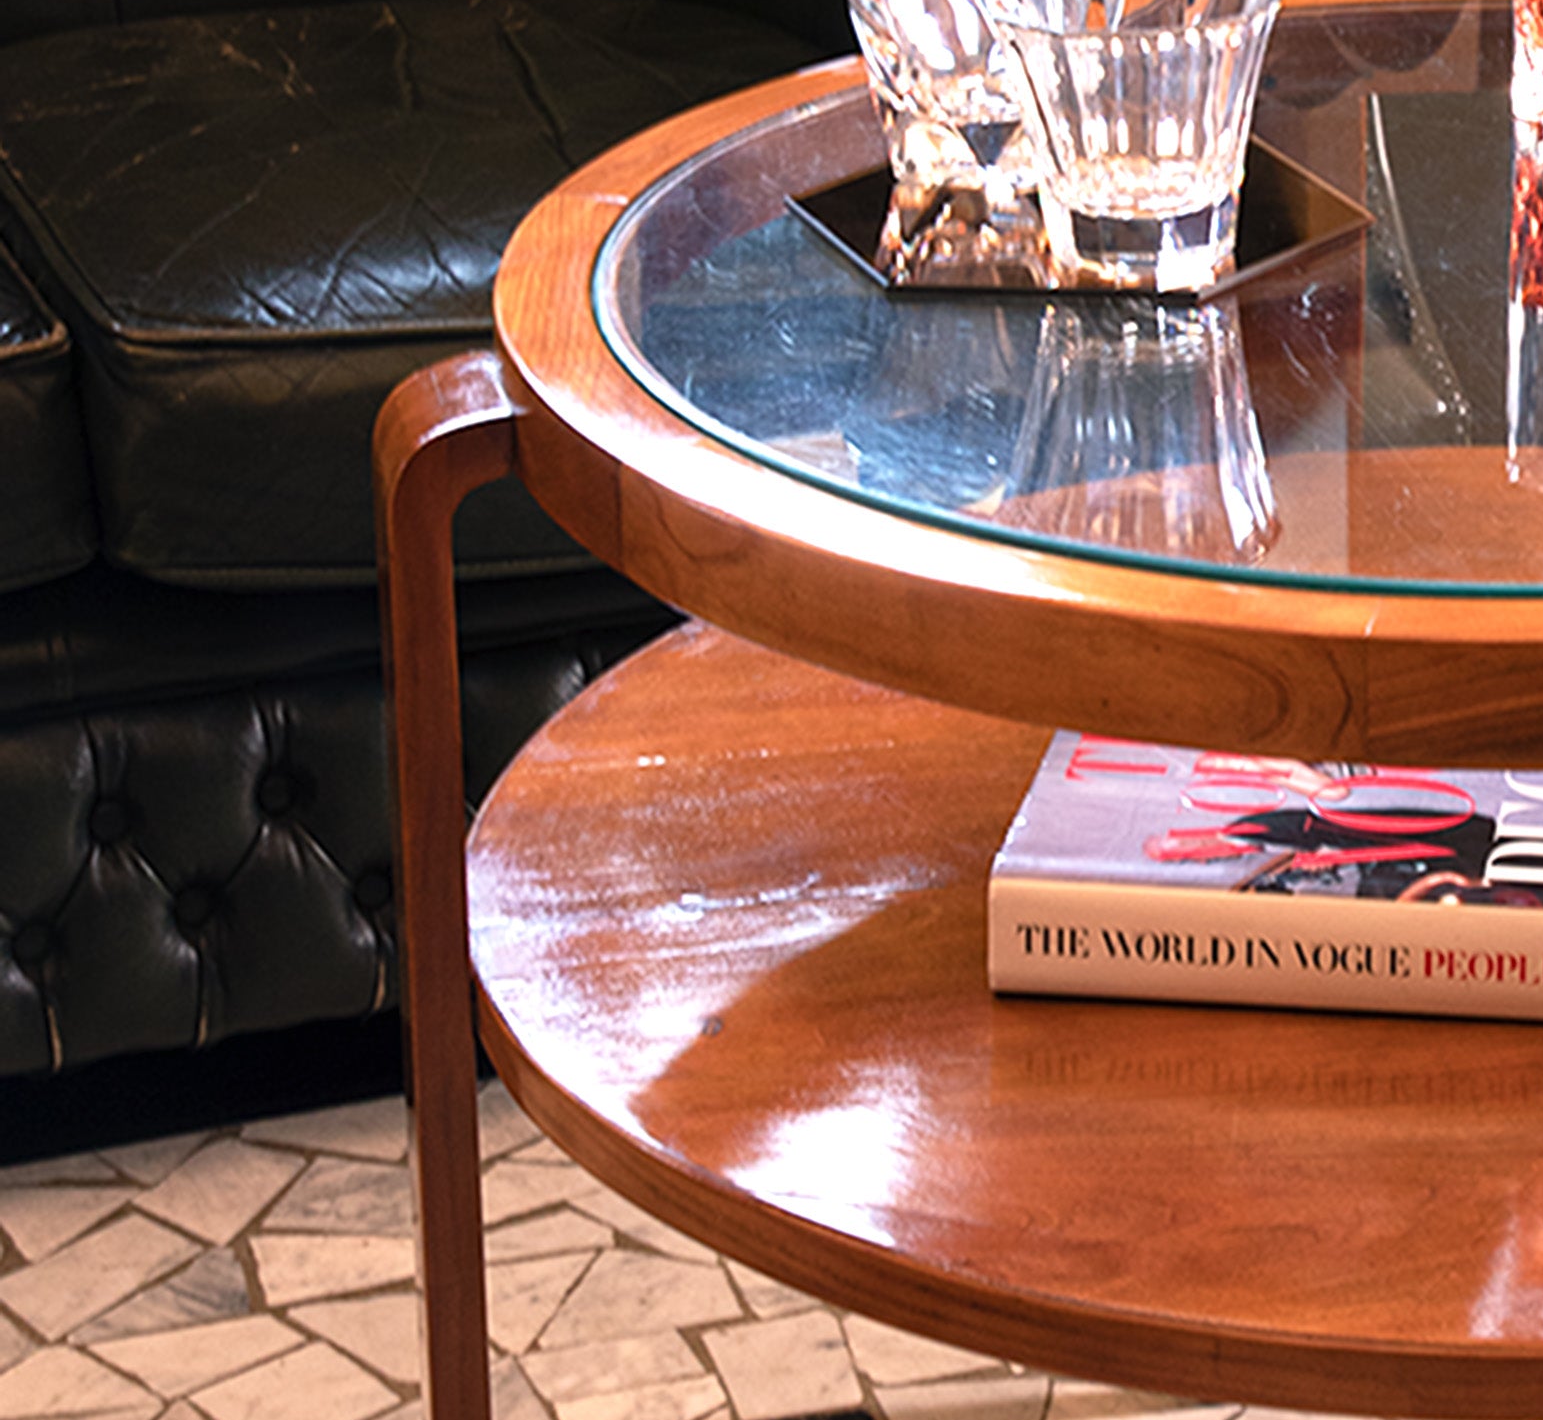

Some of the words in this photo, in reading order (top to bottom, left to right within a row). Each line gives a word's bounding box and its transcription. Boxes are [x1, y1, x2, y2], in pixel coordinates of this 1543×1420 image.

[1016, 923, 1090, 960] THE
[1100, 928, 1237, 967] WORLD
[1245, 937, 1282, 970] IN
[1292, 939, 1411, 978] VOGUE
